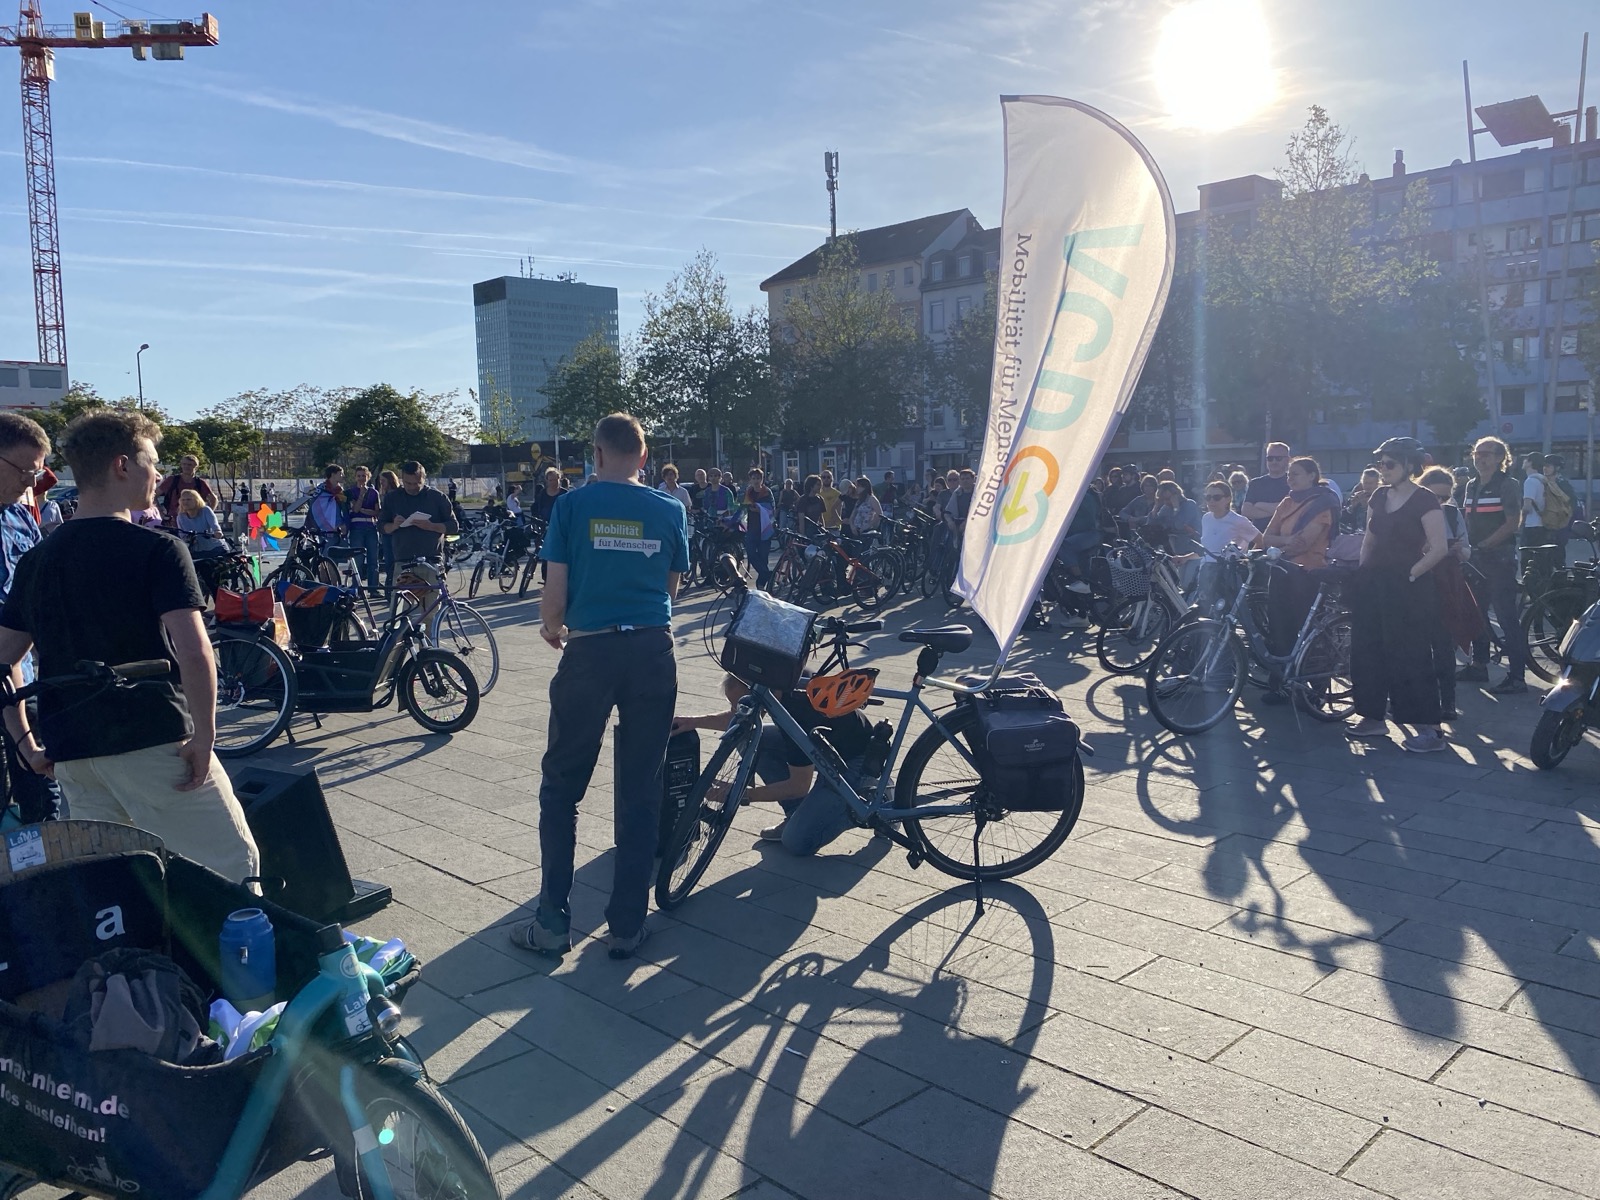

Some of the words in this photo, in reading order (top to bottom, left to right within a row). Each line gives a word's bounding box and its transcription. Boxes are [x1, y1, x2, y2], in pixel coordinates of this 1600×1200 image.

[1004, 233, 1032, 348] Mobilität
[1026, 223, 1144, 431] VCD
[1001, 354, 1022, 391] für
[594, 523, 639, 537] Mobilität
[613, 540, 657, 550] Menschen
[10, 830, 38, 847] LaMa
[25, 1099, 106, 1143] ausleihen!
